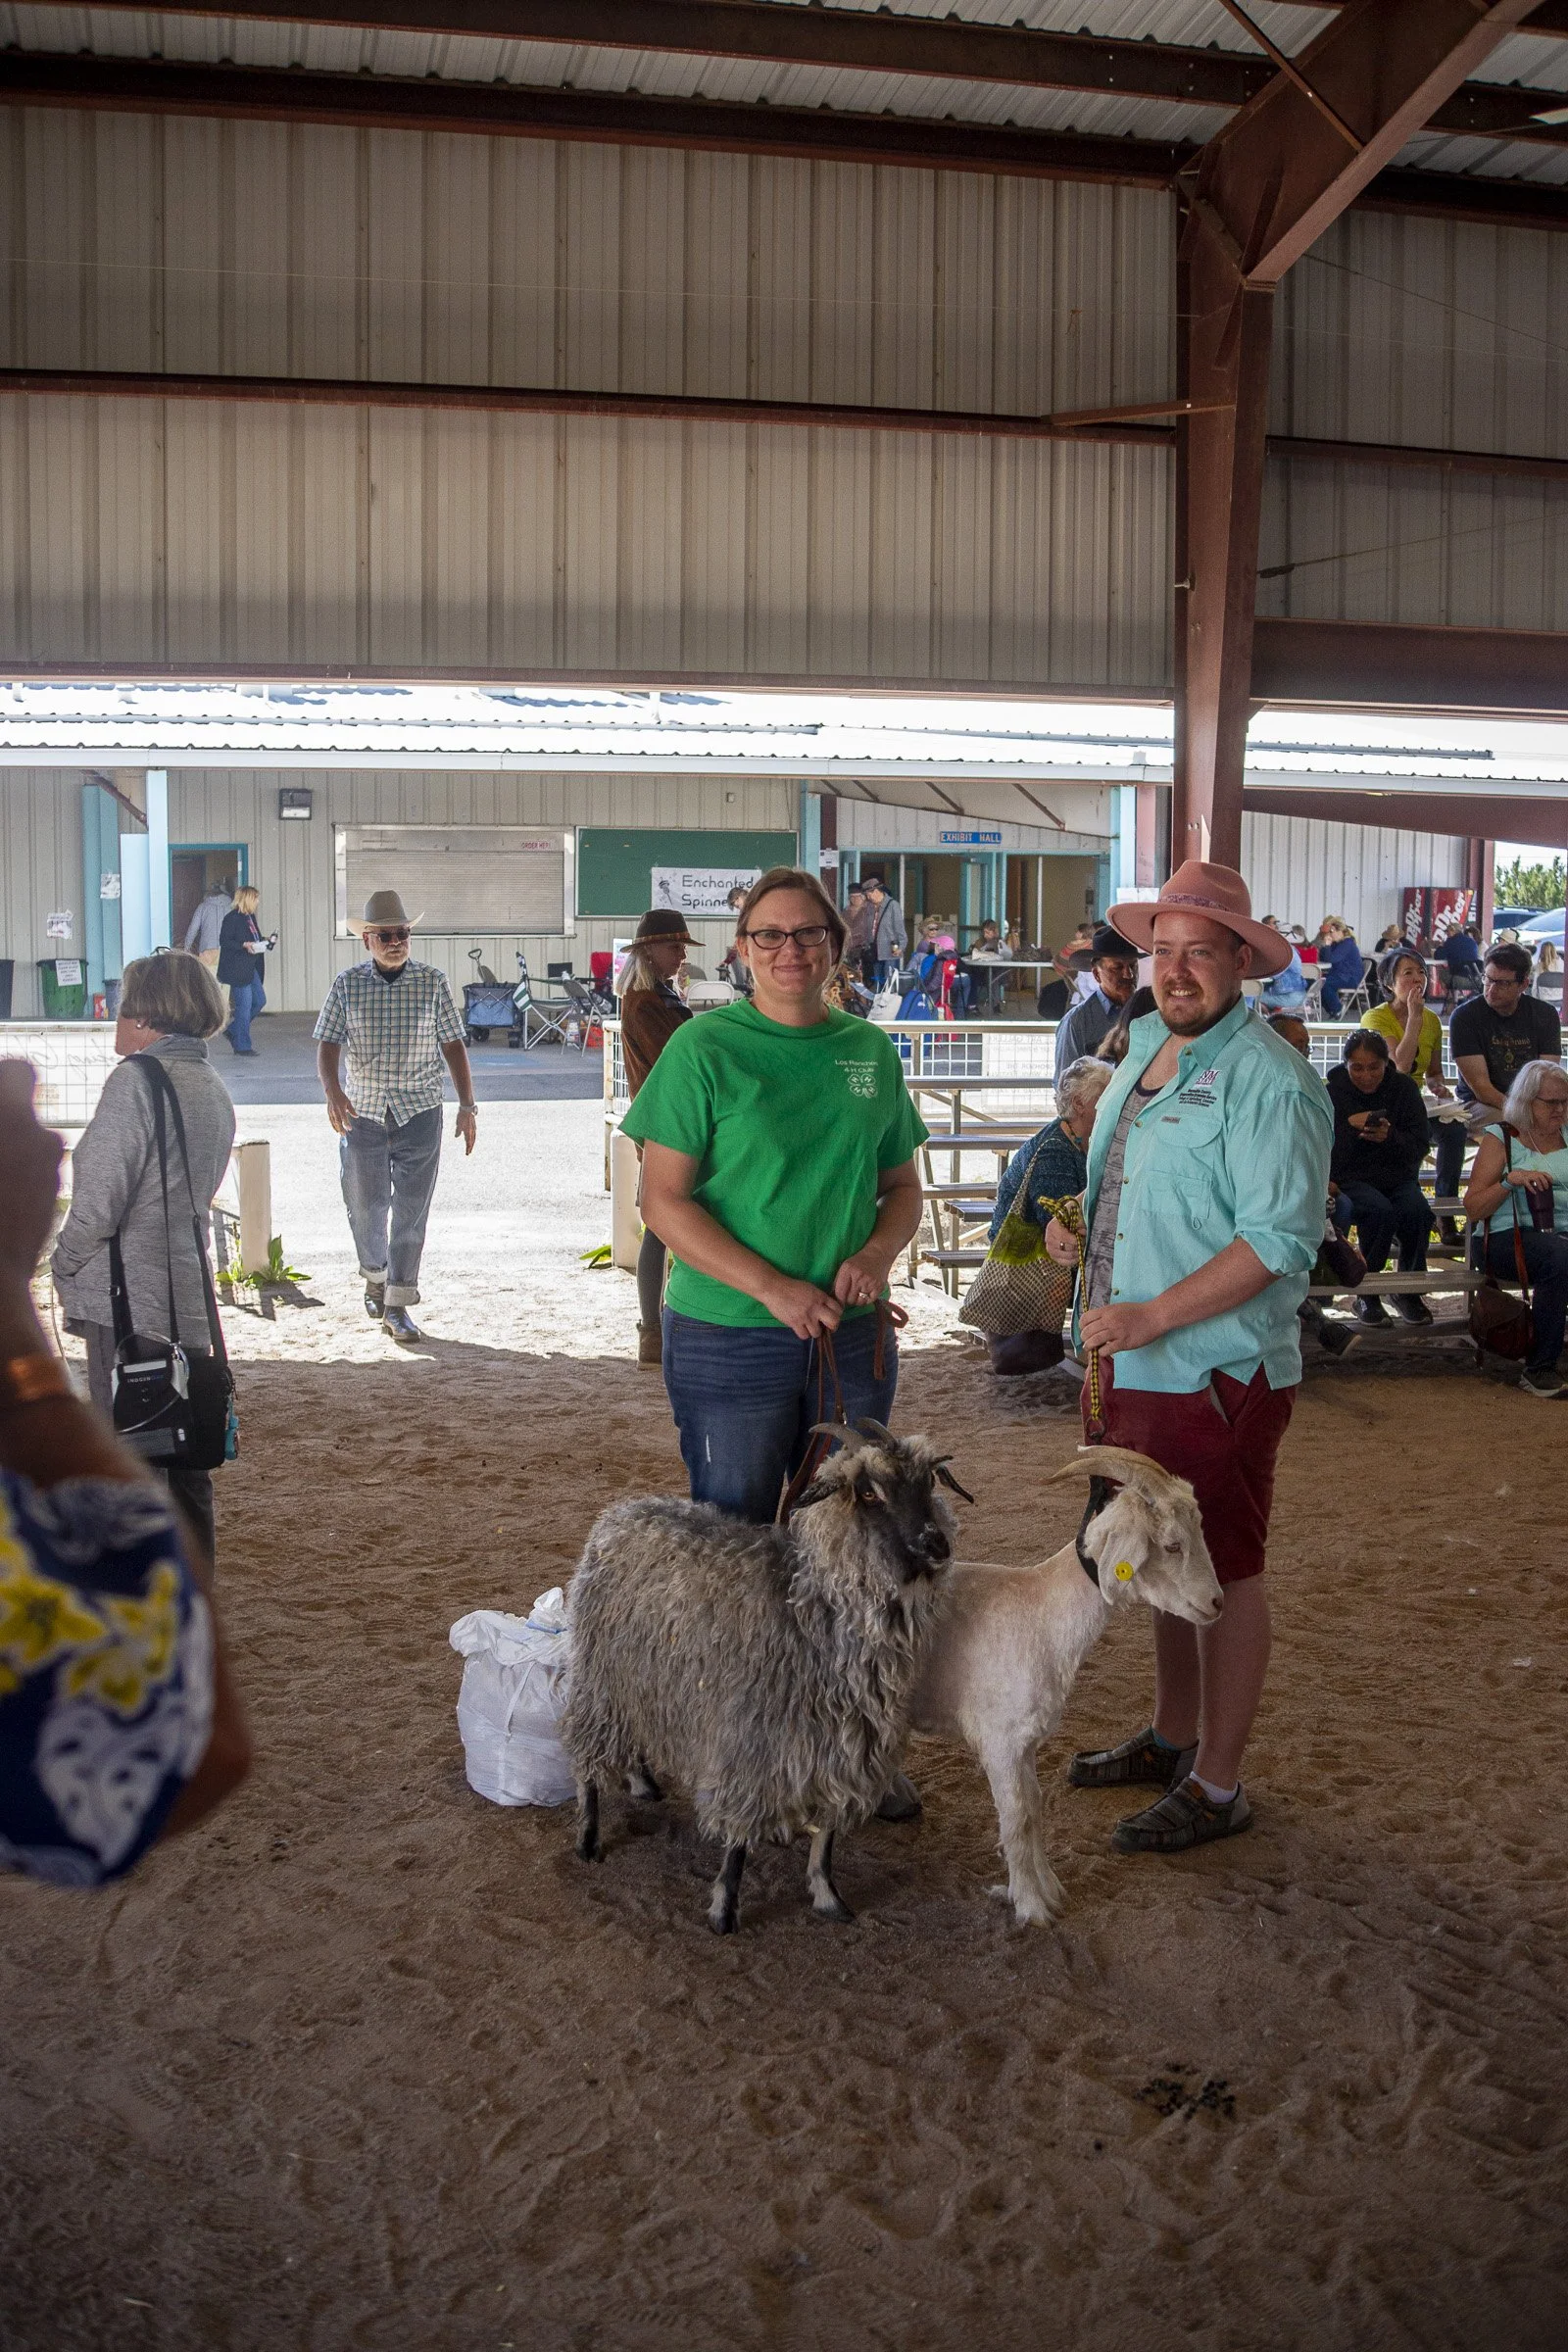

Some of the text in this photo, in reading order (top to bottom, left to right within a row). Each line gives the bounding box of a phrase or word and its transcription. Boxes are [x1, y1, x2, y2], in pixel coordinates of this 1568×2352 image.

[940, 832, 1002, 843] EXHIBIT HALL
[682, 874, 754, 889] Enchanted
[681, 893, 729, 909] Spinne
